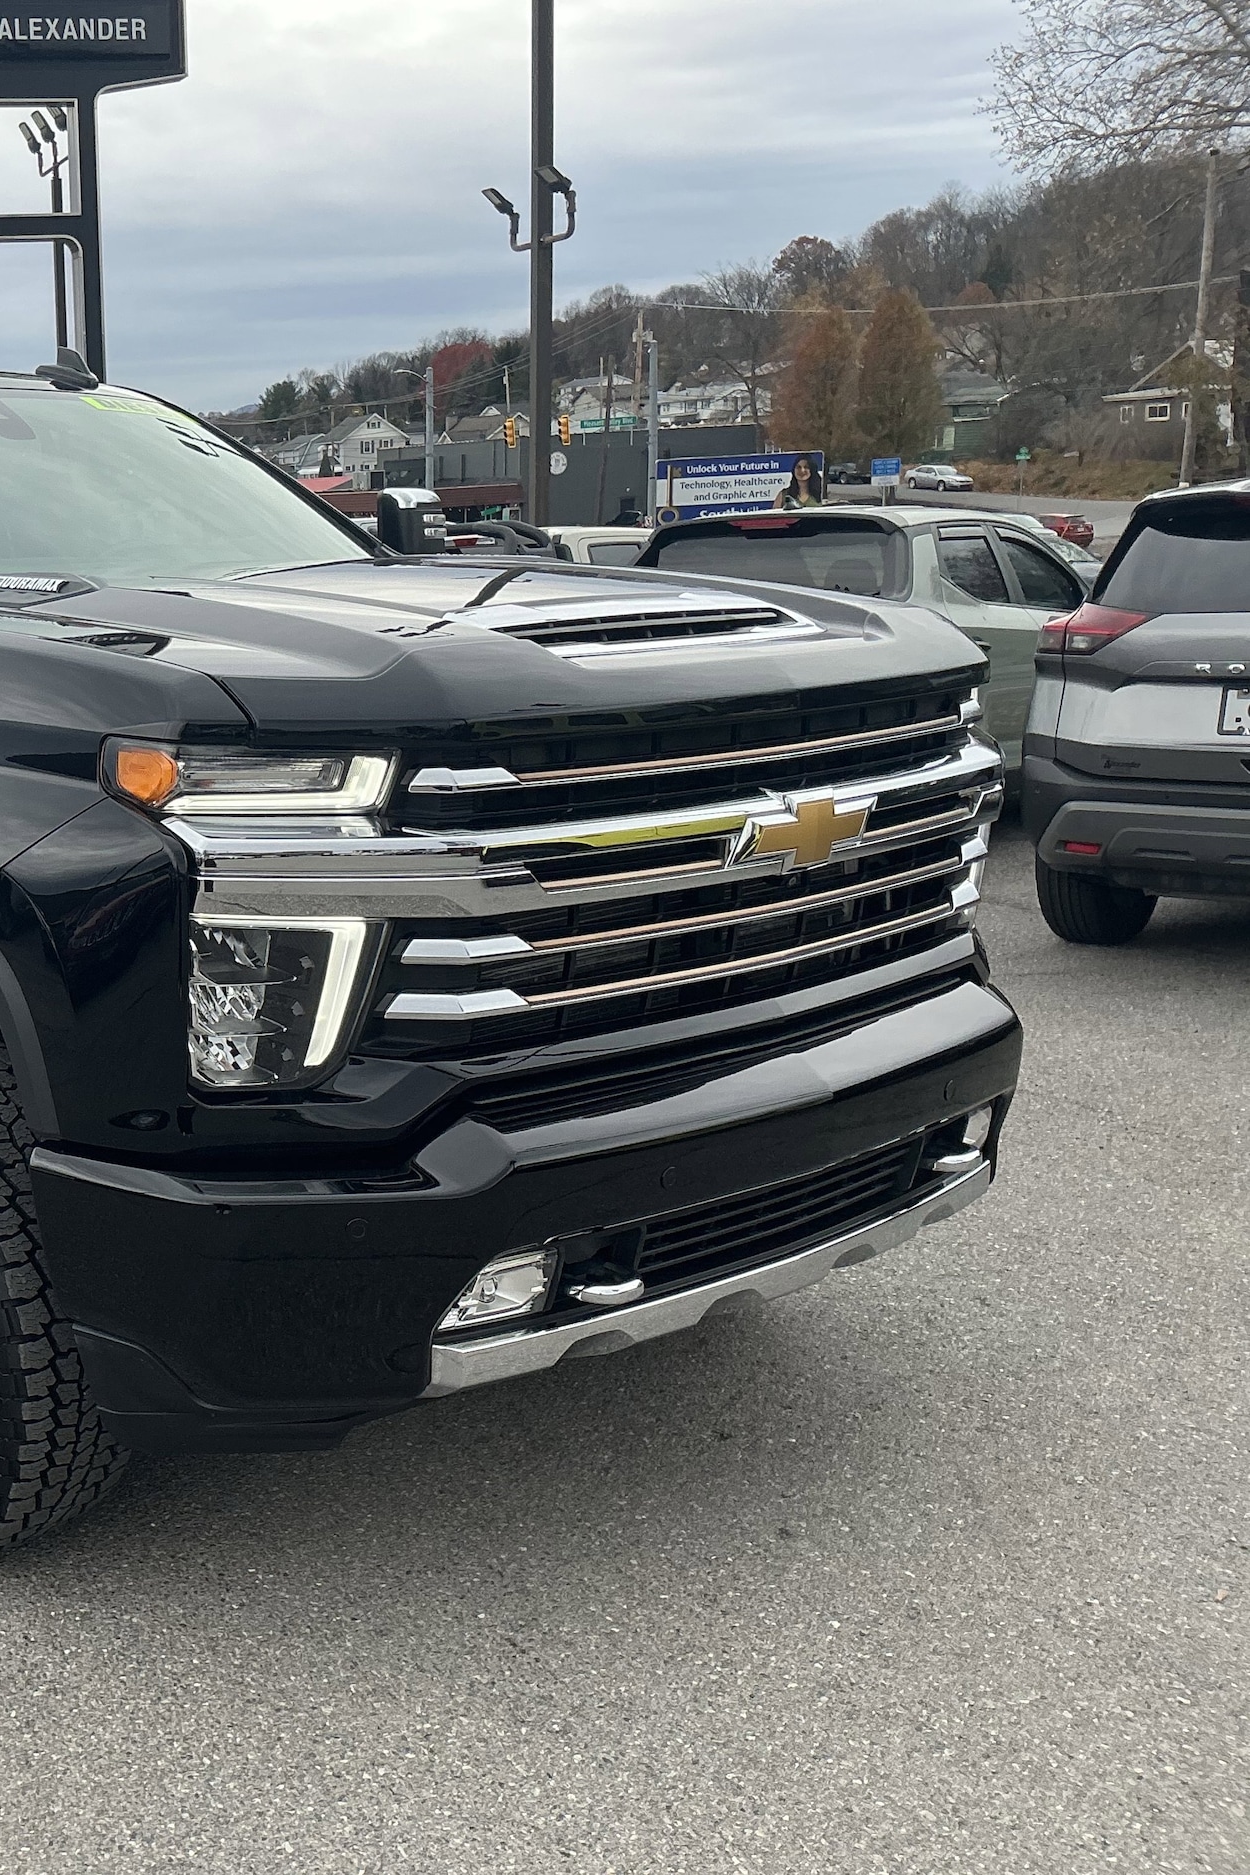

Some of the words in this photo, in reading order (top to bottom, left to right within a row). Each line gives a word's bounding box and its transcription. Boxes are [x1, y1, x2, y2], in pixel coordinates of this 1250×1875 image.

[686, 463, 718, 475] Unlock
[719, 462, 739, 473] Your
[740, 461, 769, 472] Future
[770, 460, 779, 470] in
[679, 480, 733, 490] Technology,
[734, 477, 786, 487] Healthcare,
[693, 492, 711, 502] and
[712, 490, 748, 502] Graphic
[749, 489, 771, 498] Arts!
[1, 576, 64, 592] DURAMAX
